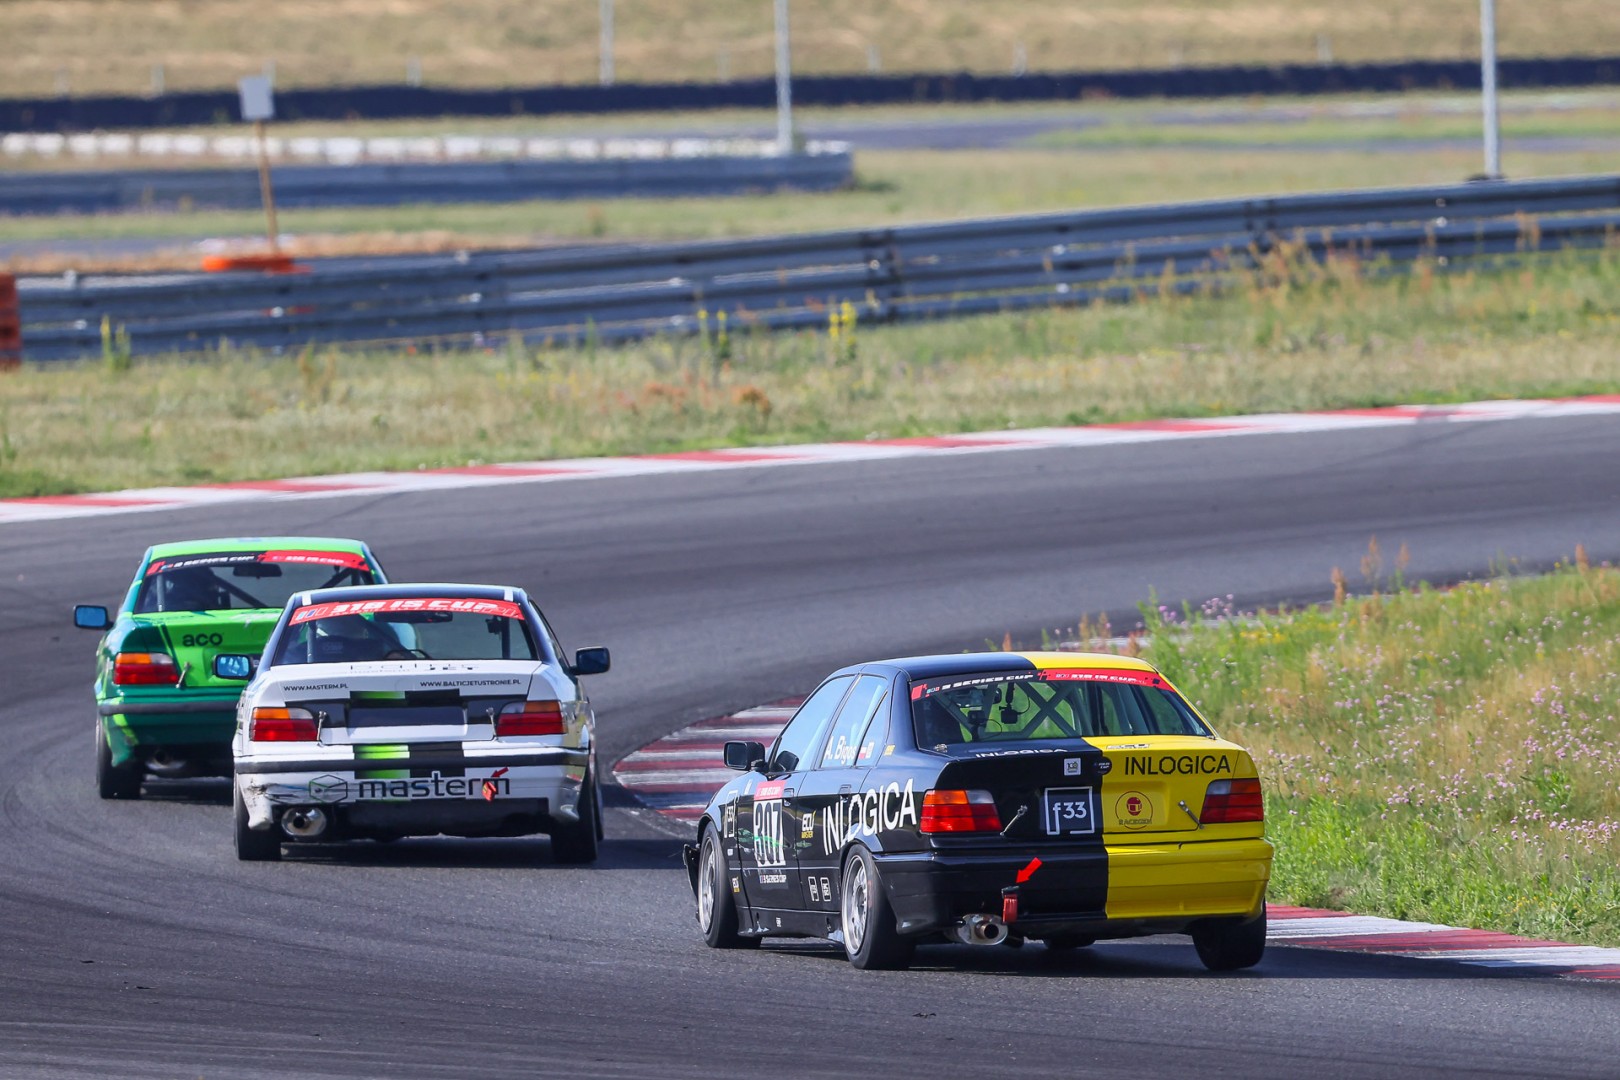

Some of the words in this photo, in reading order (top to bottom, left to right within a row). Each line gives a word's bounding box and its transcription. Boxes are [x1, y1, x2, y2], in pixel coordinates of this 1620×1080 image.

[332, 601, 386, 613] 318
[390, 600, 426, 608] IS
[428, 600, 498, 610] CUP
[182, 632, 223, 648] aco
[284, 683, 349, 691] WWW.MASTERM.PL
[823, 736, 833, 760] A.
[1124, 755, 1231, 775] INLOGICA
[358, 772, 511, 799] masterm
[822, 777, 918, 856] INLOGICA
